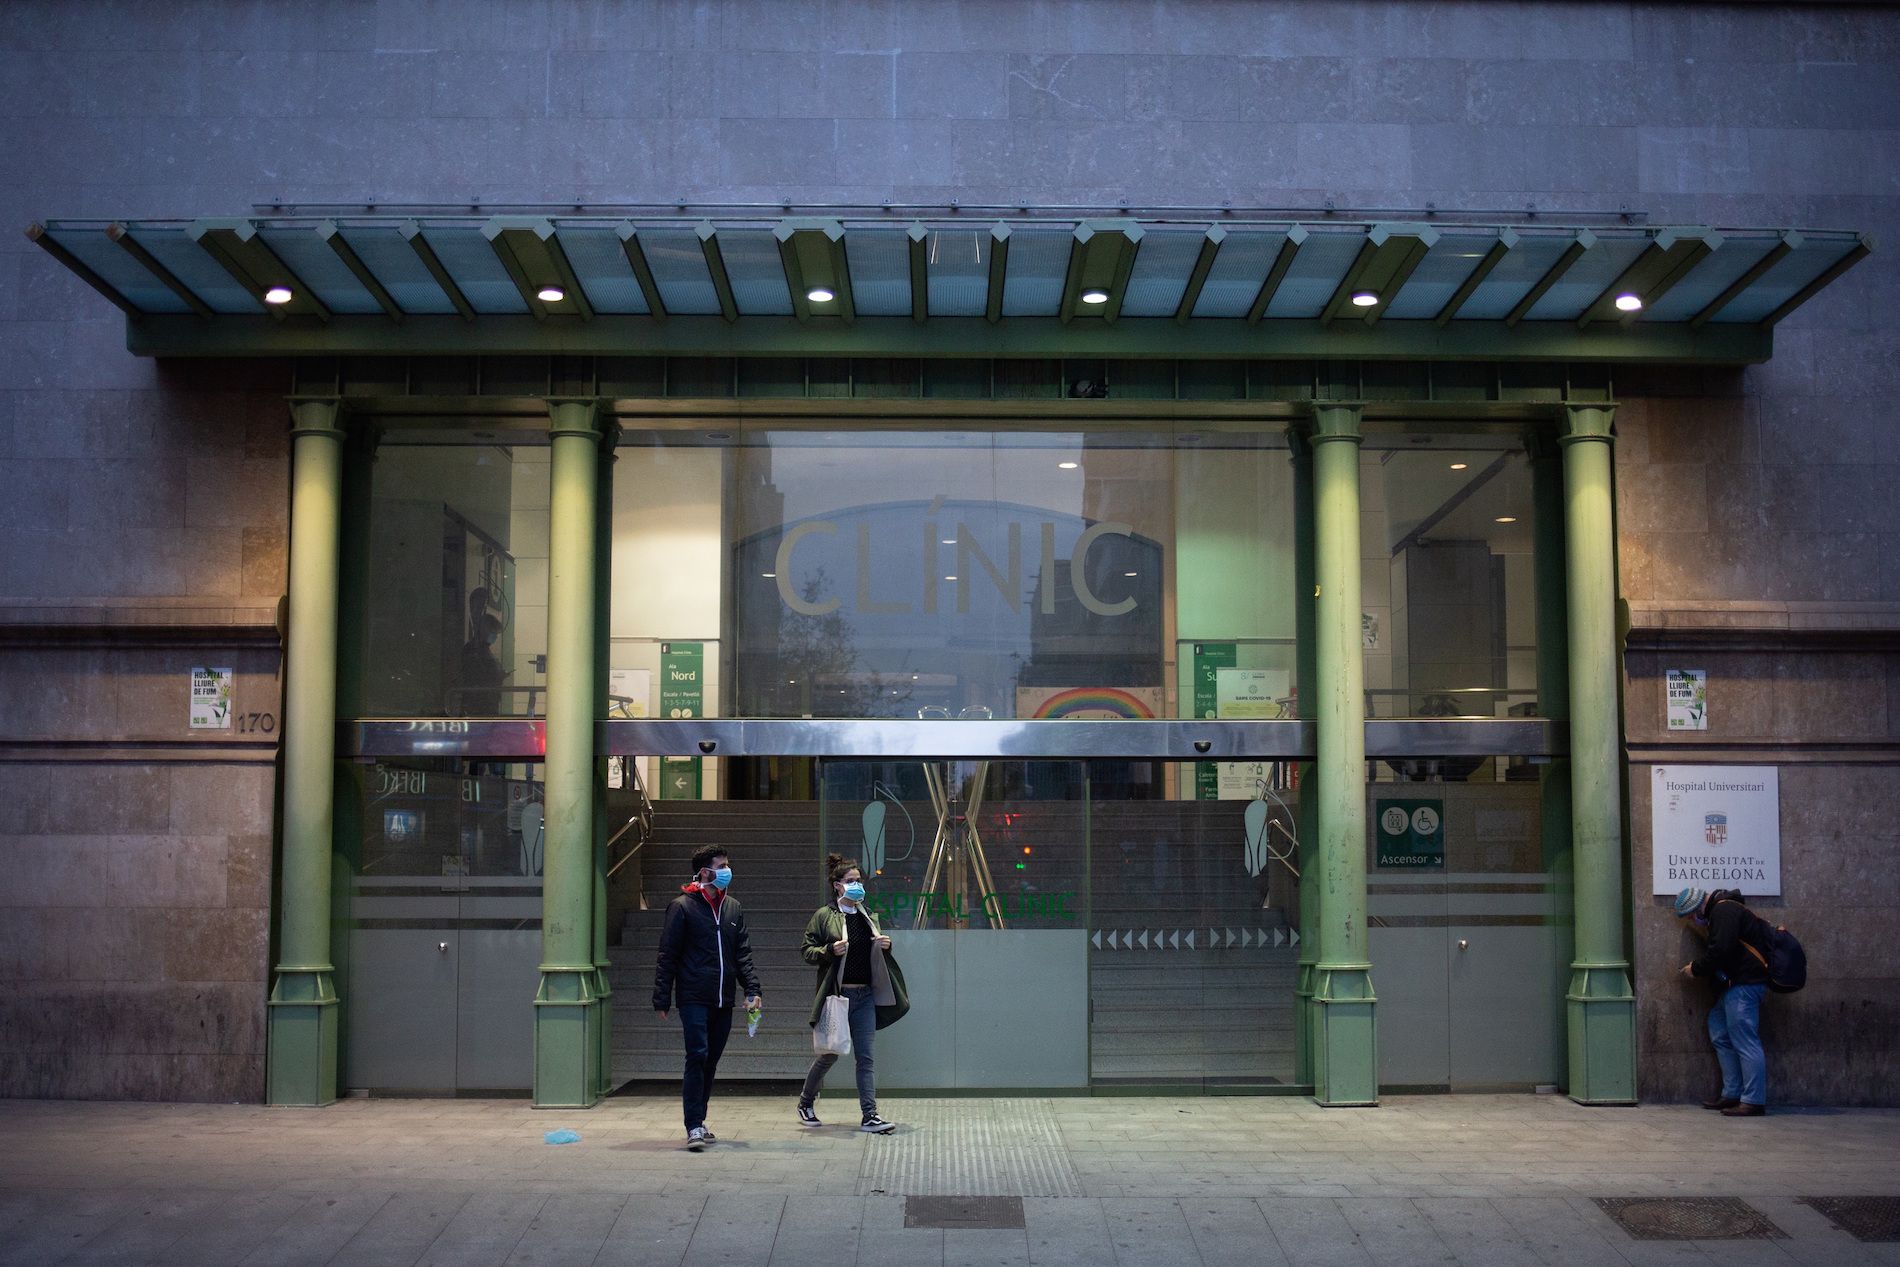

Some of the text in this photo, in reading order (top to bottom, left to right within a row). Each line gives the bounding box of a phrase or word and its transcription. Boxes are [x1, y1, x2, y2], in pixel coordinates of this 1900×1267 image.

[775, 494, 1138, 616] CLÍNIC
[194, 671, 223, 679] HOSPITAL
[671, 671, 696, 681] Nord
[1206, 671, 1217, 682] Su
[1669, 674, 1698, 682] HOSPITAL
[194, 680, 215, 688] LLIURE
[1669, 682, 1690, 690] LLIURE
[193, 688, 217, 696] DE FUM
[1669, 690, 1692, 698] DE FUM
[238, 711, 276, 734] 170
[1666, 781, 1765, 793] Hospital Universitari
[1381, 854, 1428, 864] Ascensor
[1668, 868, 1766, 881] BARCELONA
[865, 887, 1079, 920] SPITAL CLÍNIC
